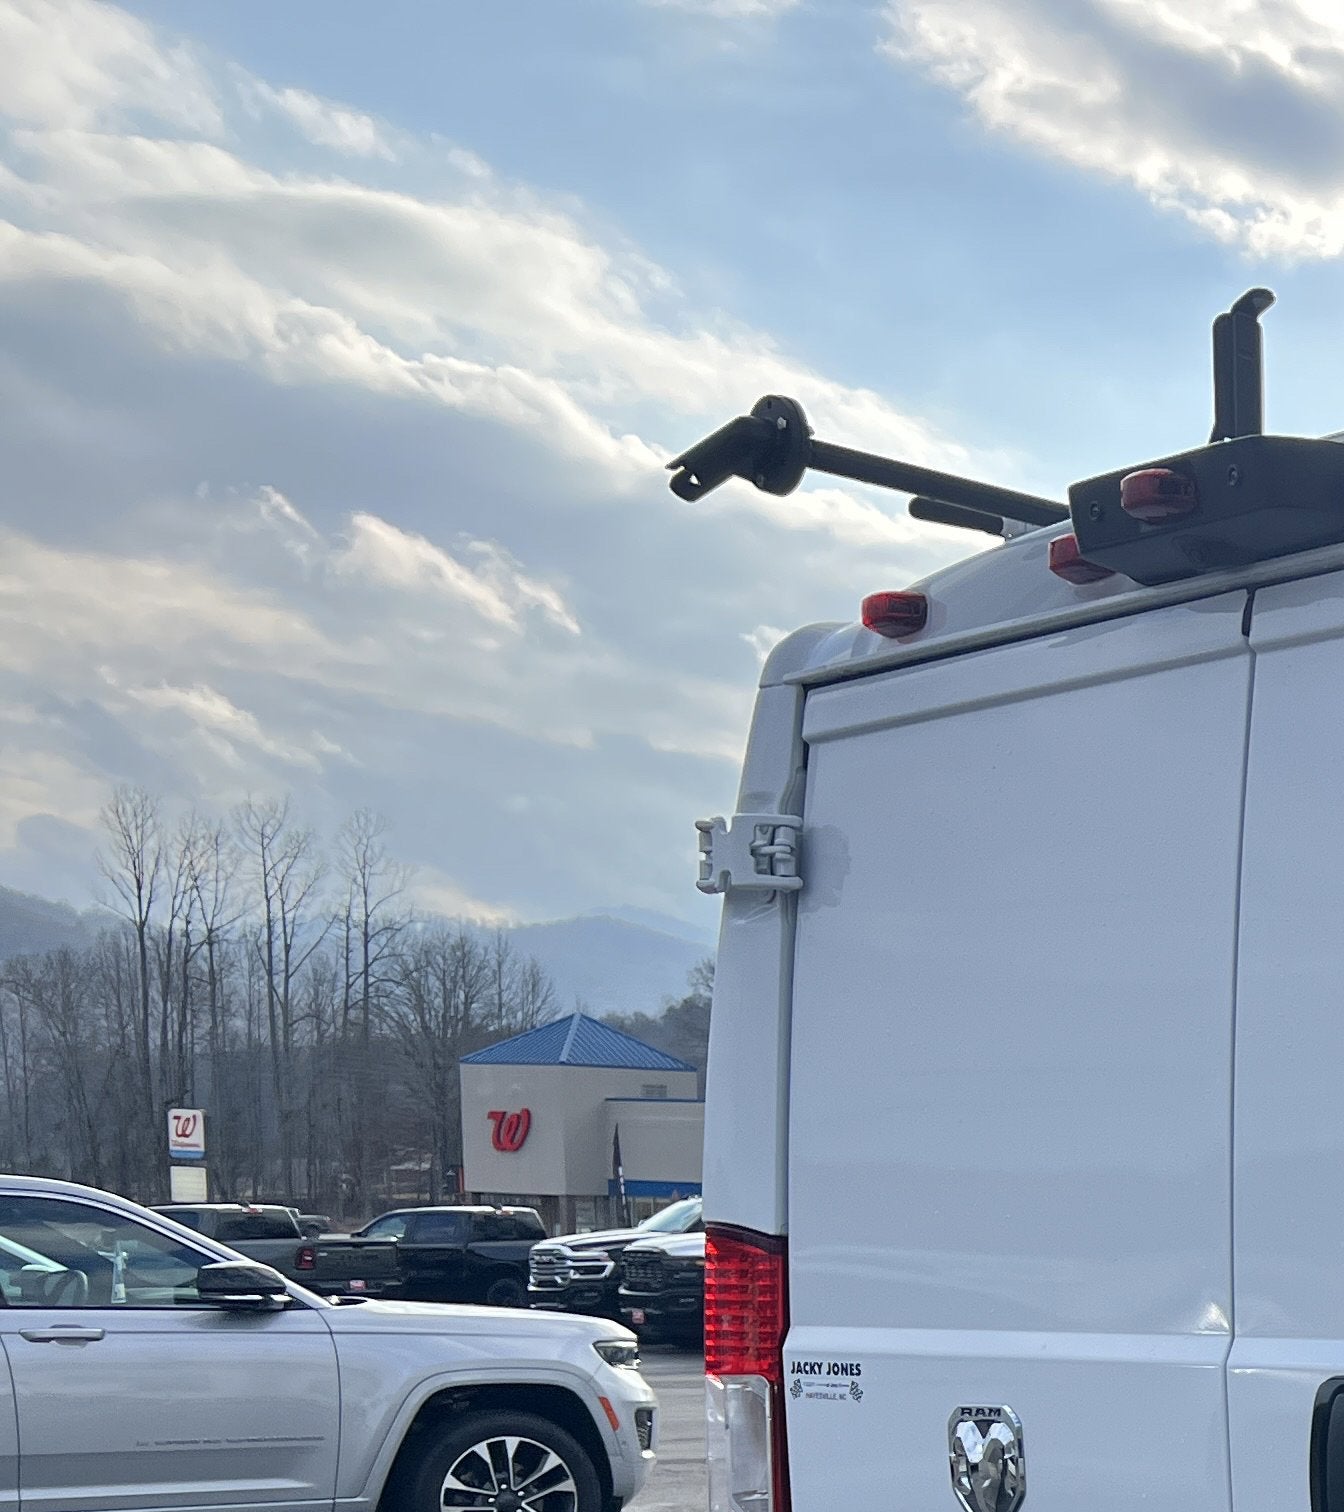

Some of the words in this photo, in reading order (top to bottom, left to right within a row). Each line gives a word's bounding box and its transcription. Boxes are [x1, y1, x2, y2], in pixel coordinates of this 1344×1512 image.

[173, 1114, 197, 1138] W
[487, 1108, 531, 1152] W
[790, 1361, 823, 1375] JACKY
[826, 1362, 862, 1377] JONES
[960, 1407, 1001, 1417] RAM
